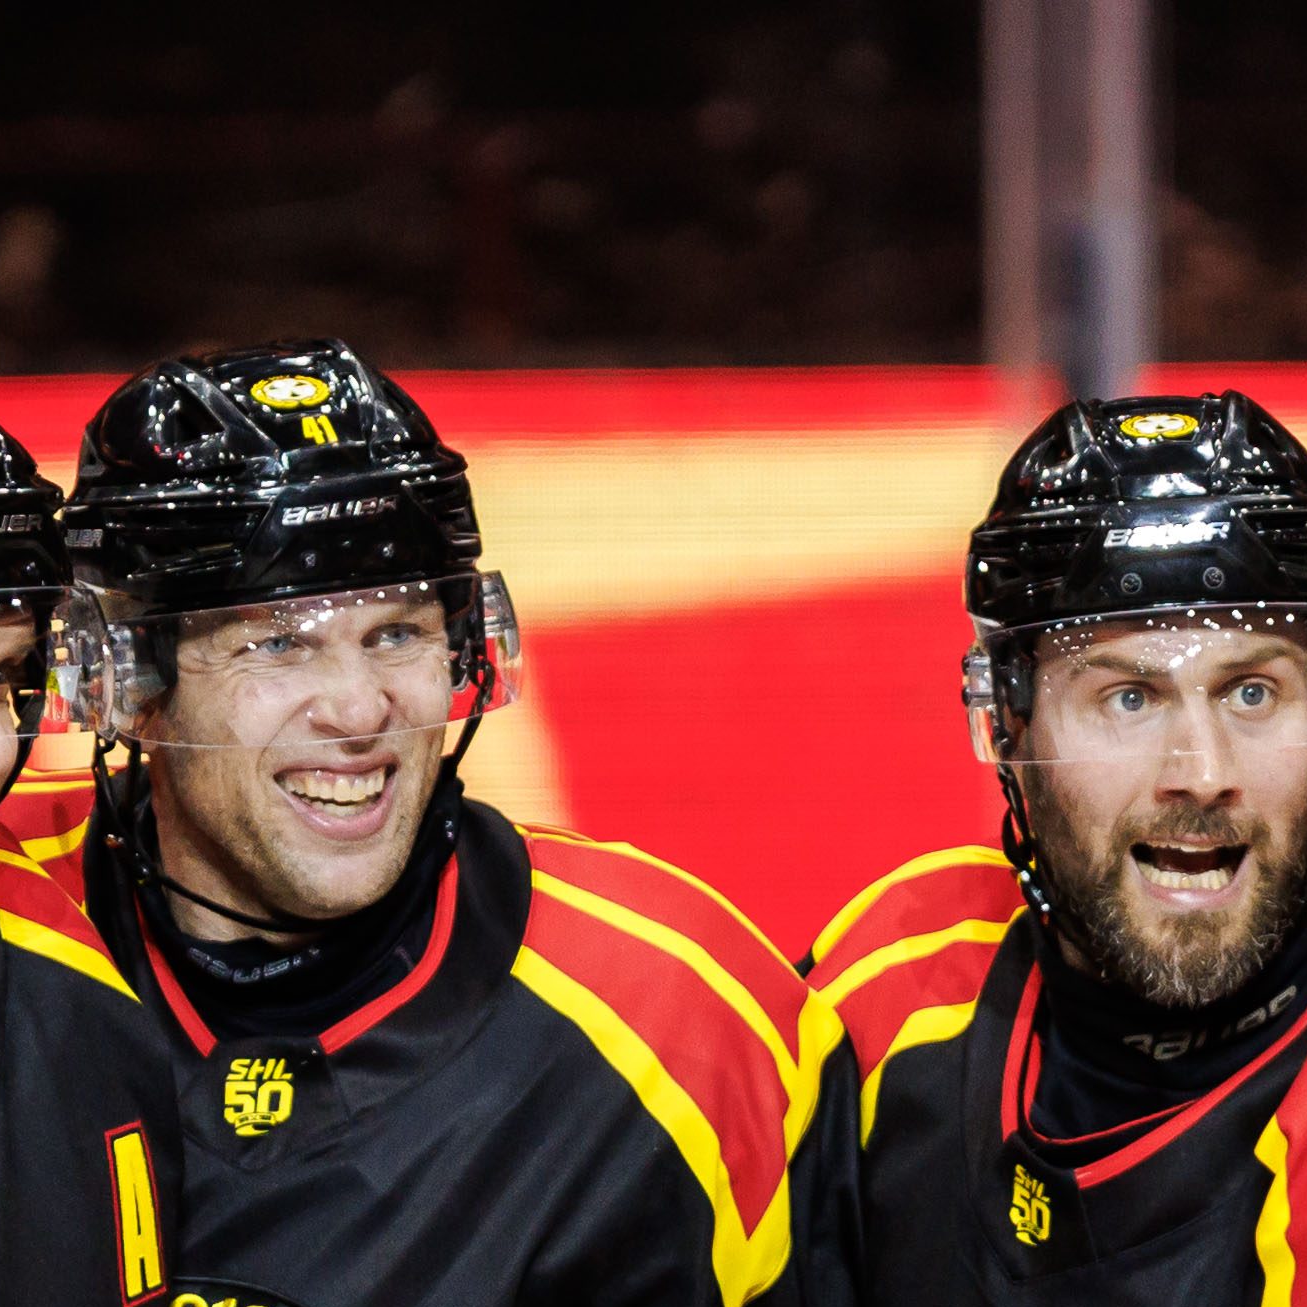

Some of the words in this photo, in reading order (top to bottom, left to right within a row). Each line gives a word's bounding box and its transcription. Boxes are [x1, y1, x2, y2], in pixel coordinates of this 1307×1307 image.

[301, 413, 339, 446] 41
[226, 1058, 293, 1081] SHL
[223, 1080, 294, 1125] 50
[1009, 1182, 1051, 1242] 50
